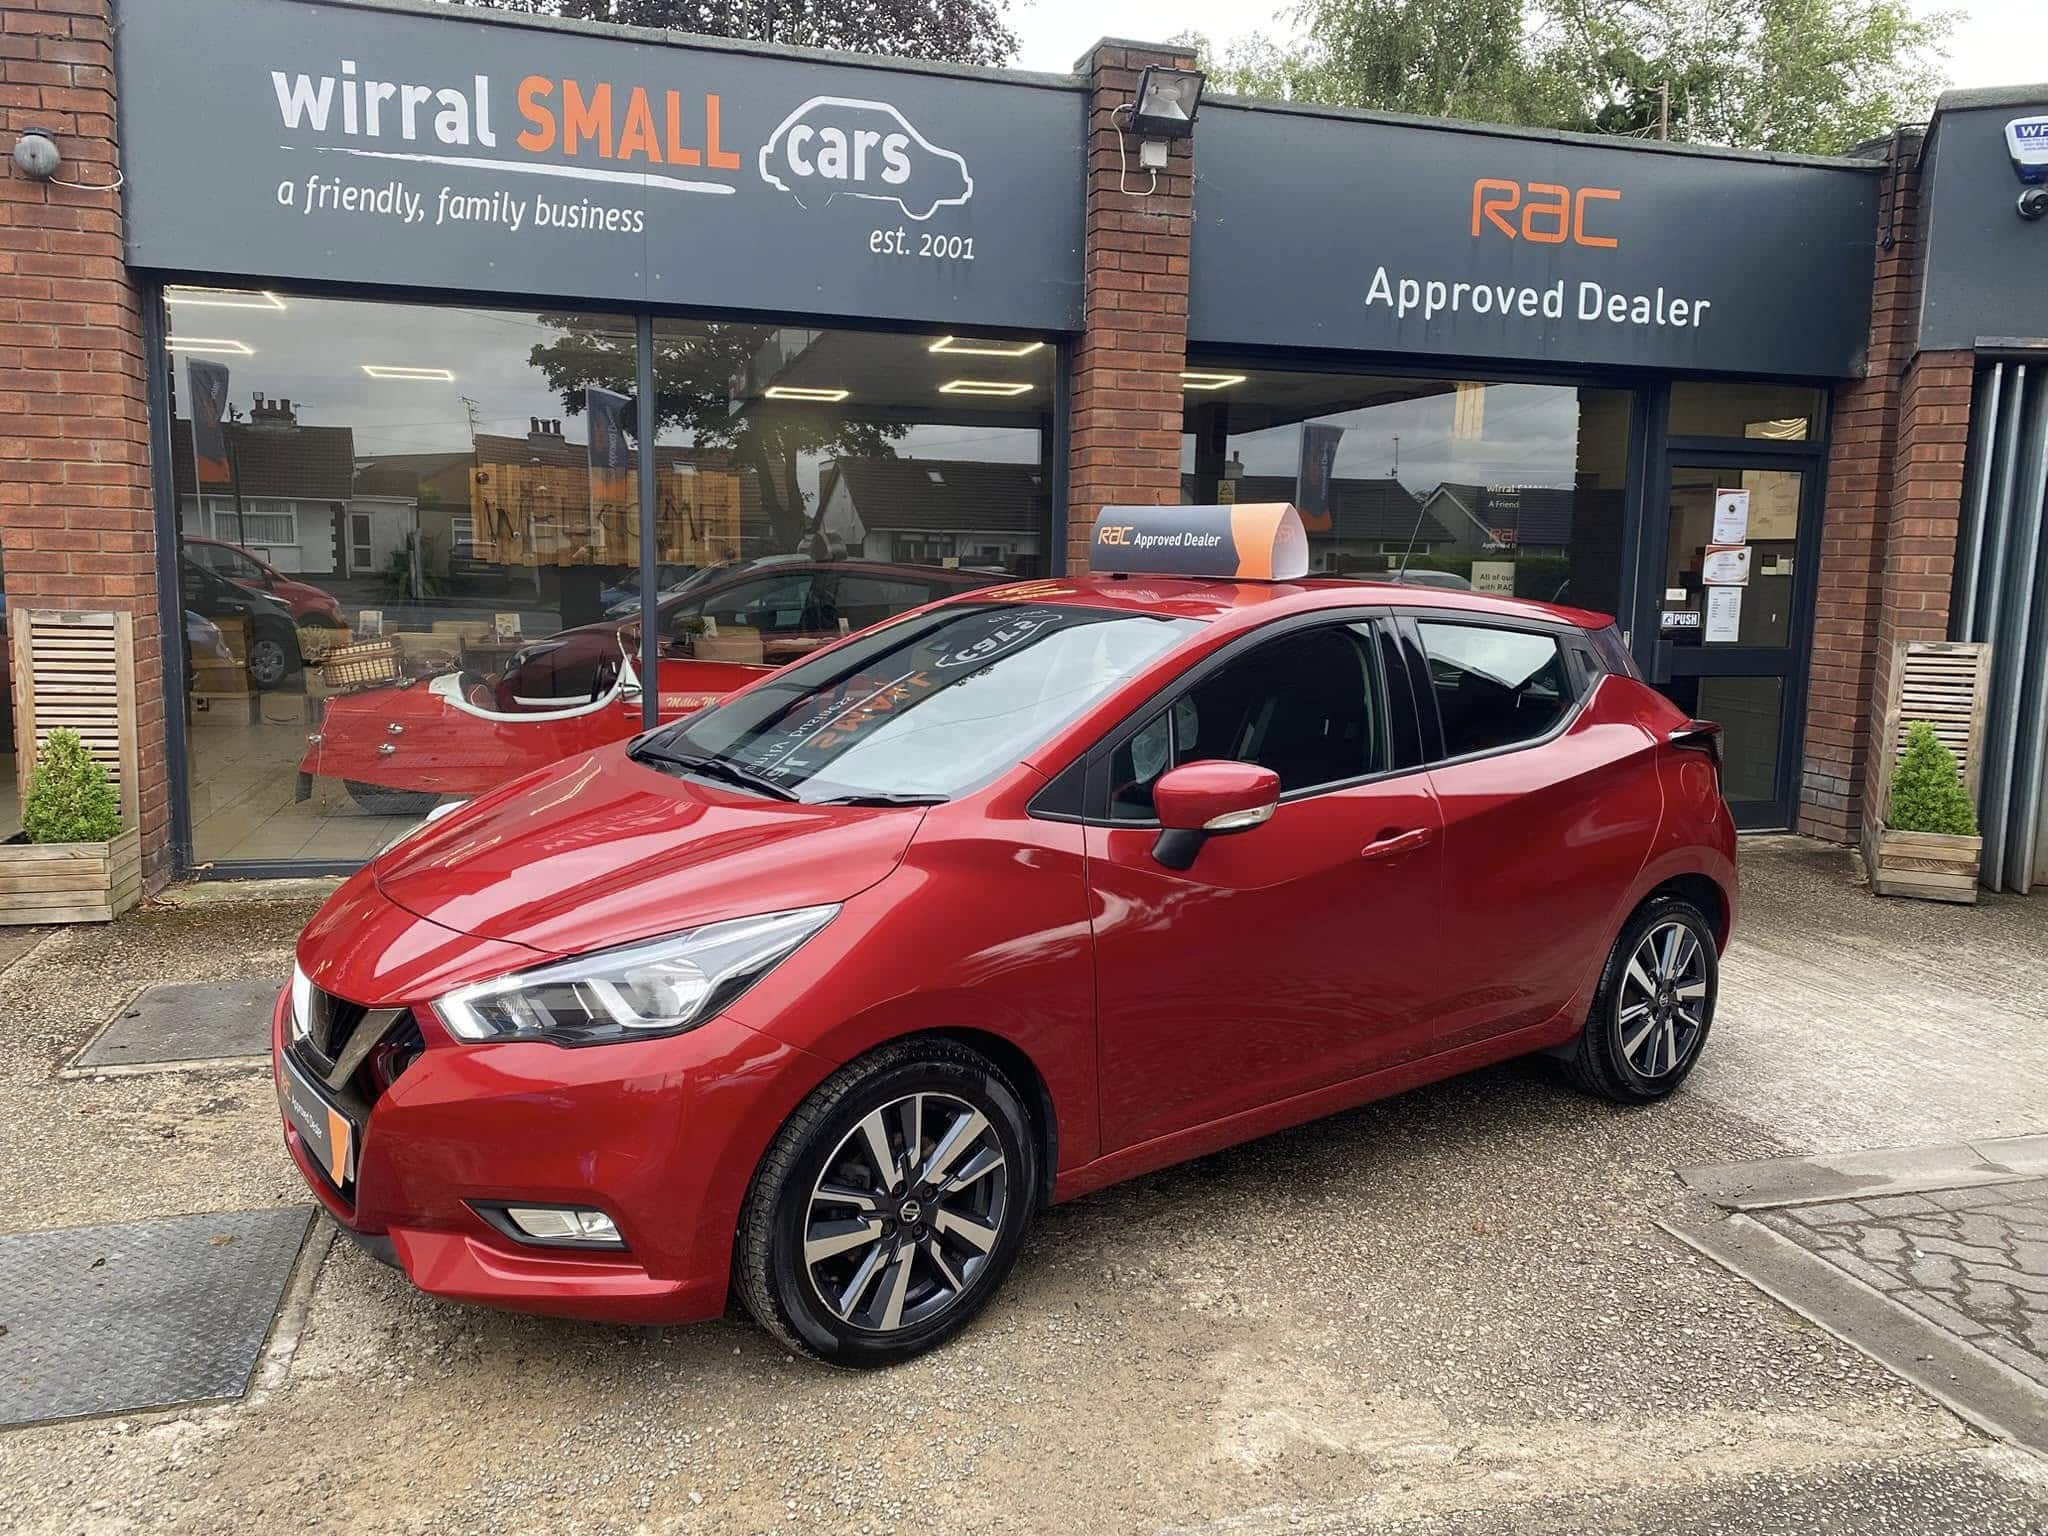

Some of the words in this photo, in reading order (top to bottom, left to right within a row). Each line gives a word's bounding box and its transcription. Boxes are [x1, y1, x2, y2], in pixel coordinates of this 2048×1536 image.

[271, 60, 496, 147] wirral
[516, 75, 740, 170] SMALL
[787, 124, 911, 184] cars
[277, 181, 294, 205] a
[304, 175, 425, 223] friendly,
[436, 187, 526, 231] family
[534, 194, 644, 232] business
[870, 226, 911, 255] est.
[919, 234, 975, 259] 2001
[1365, 266, 1564, 320] Approved
[1578, 281, 1711, 327] Dealer
[1134, 532, 1182, 548] Approved
[1184, 533, 1221, 547] Dealer
[1674, 613, 1698, 625] PUSH
